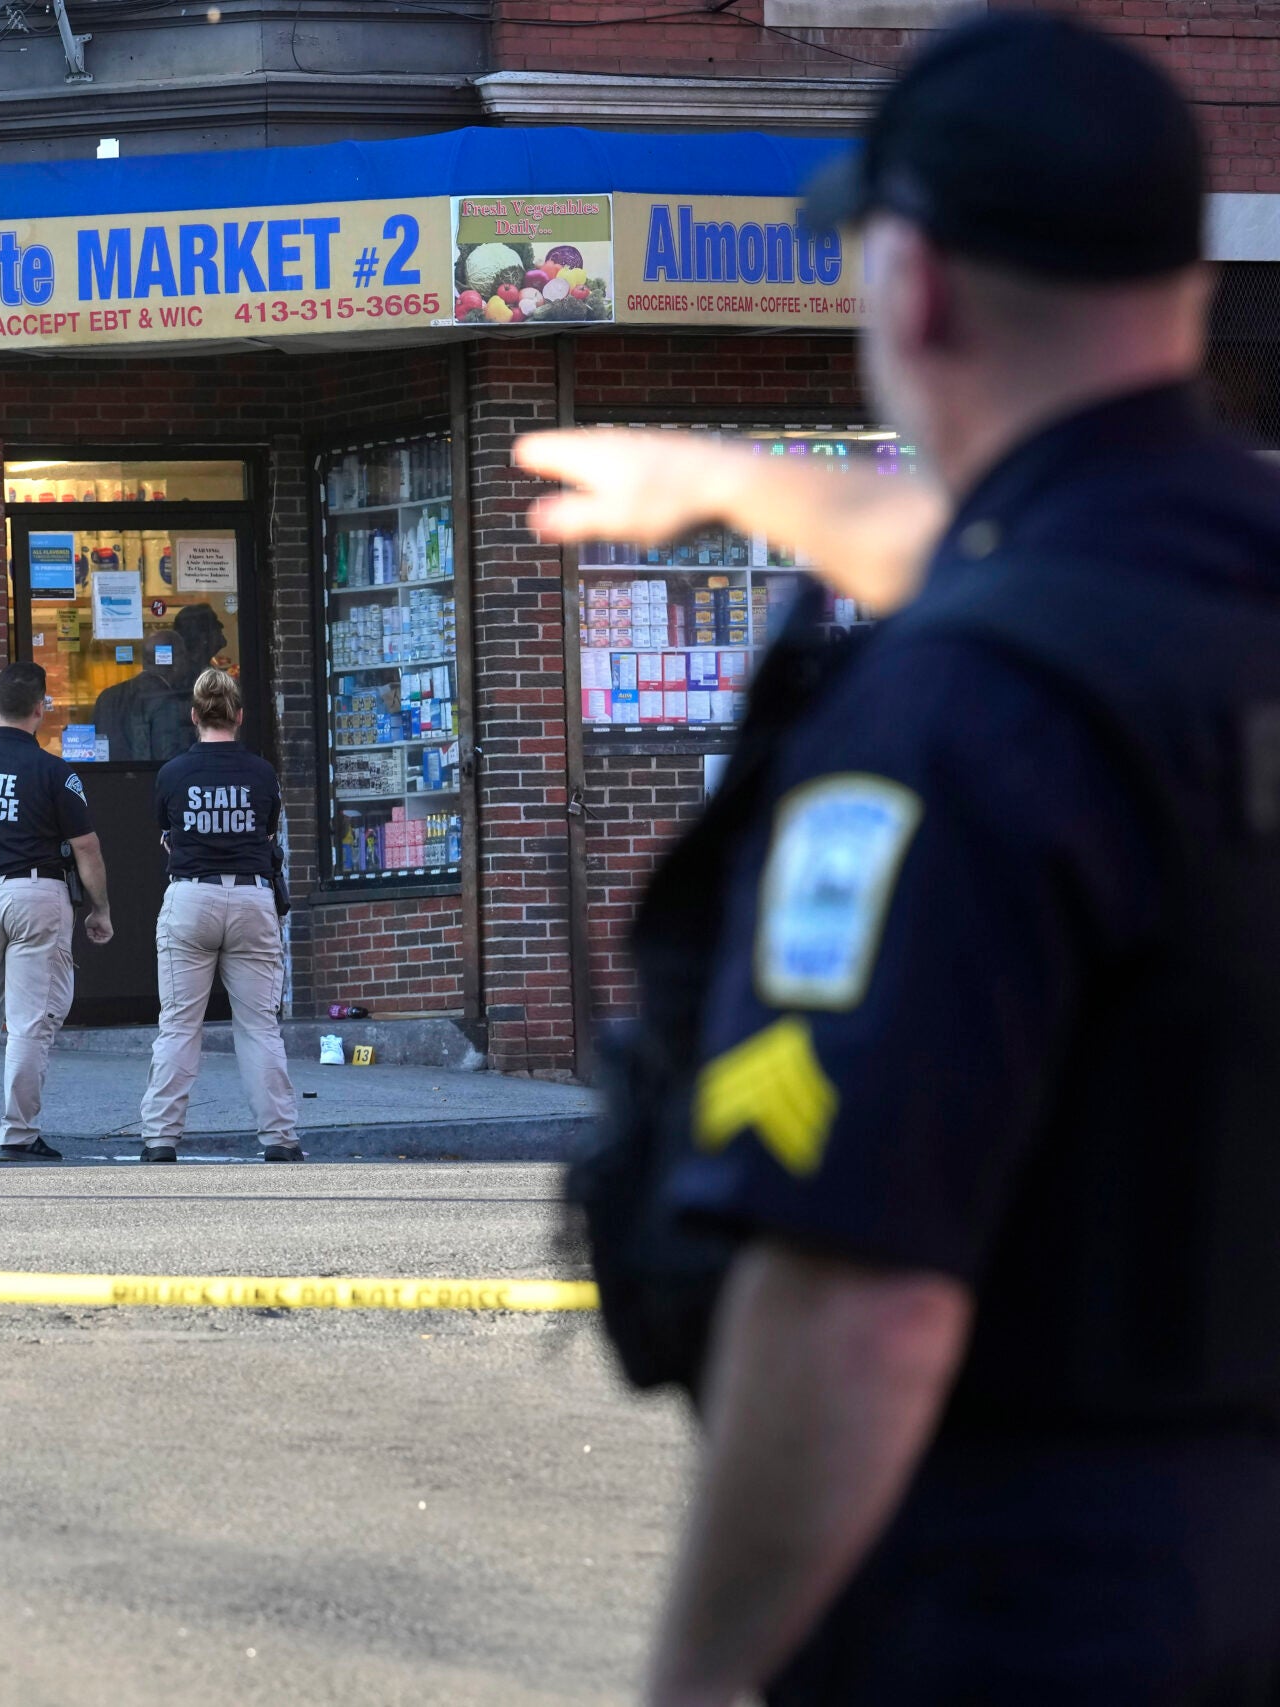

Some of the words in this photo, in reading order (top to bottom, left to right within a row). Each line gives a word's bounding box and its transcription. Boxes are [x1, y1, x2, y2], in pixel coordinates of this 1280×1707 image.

[461, 200, 507, 217] Fresh
[511, 198, 599, 220] Vegetables
[495, 220, 552, 239] Daily...
[77, 216, 340, 301] MARKET
[352, 213, 421, 289] #2
[643, 204, 842, 286] Almonte
[234, 292, 441, 324] 413-315-3665
[627, 294, 689, 312] GROCERIES
[696, 295, 714, 312] ICE
[716, 296, 754, 313] CREAM
[760, 296, 801, 313] COFFEE
[808, 297, 829, 313] TEA
[835, 297, 858, 314] HOT
[89, 308, 132, 332] EBT
[138, 309, 154, 329] &
[159, 305, 204, 328] WIC
[183, 810, 256, 834] POLICE
[356, 1049, 370, 1062] 13
